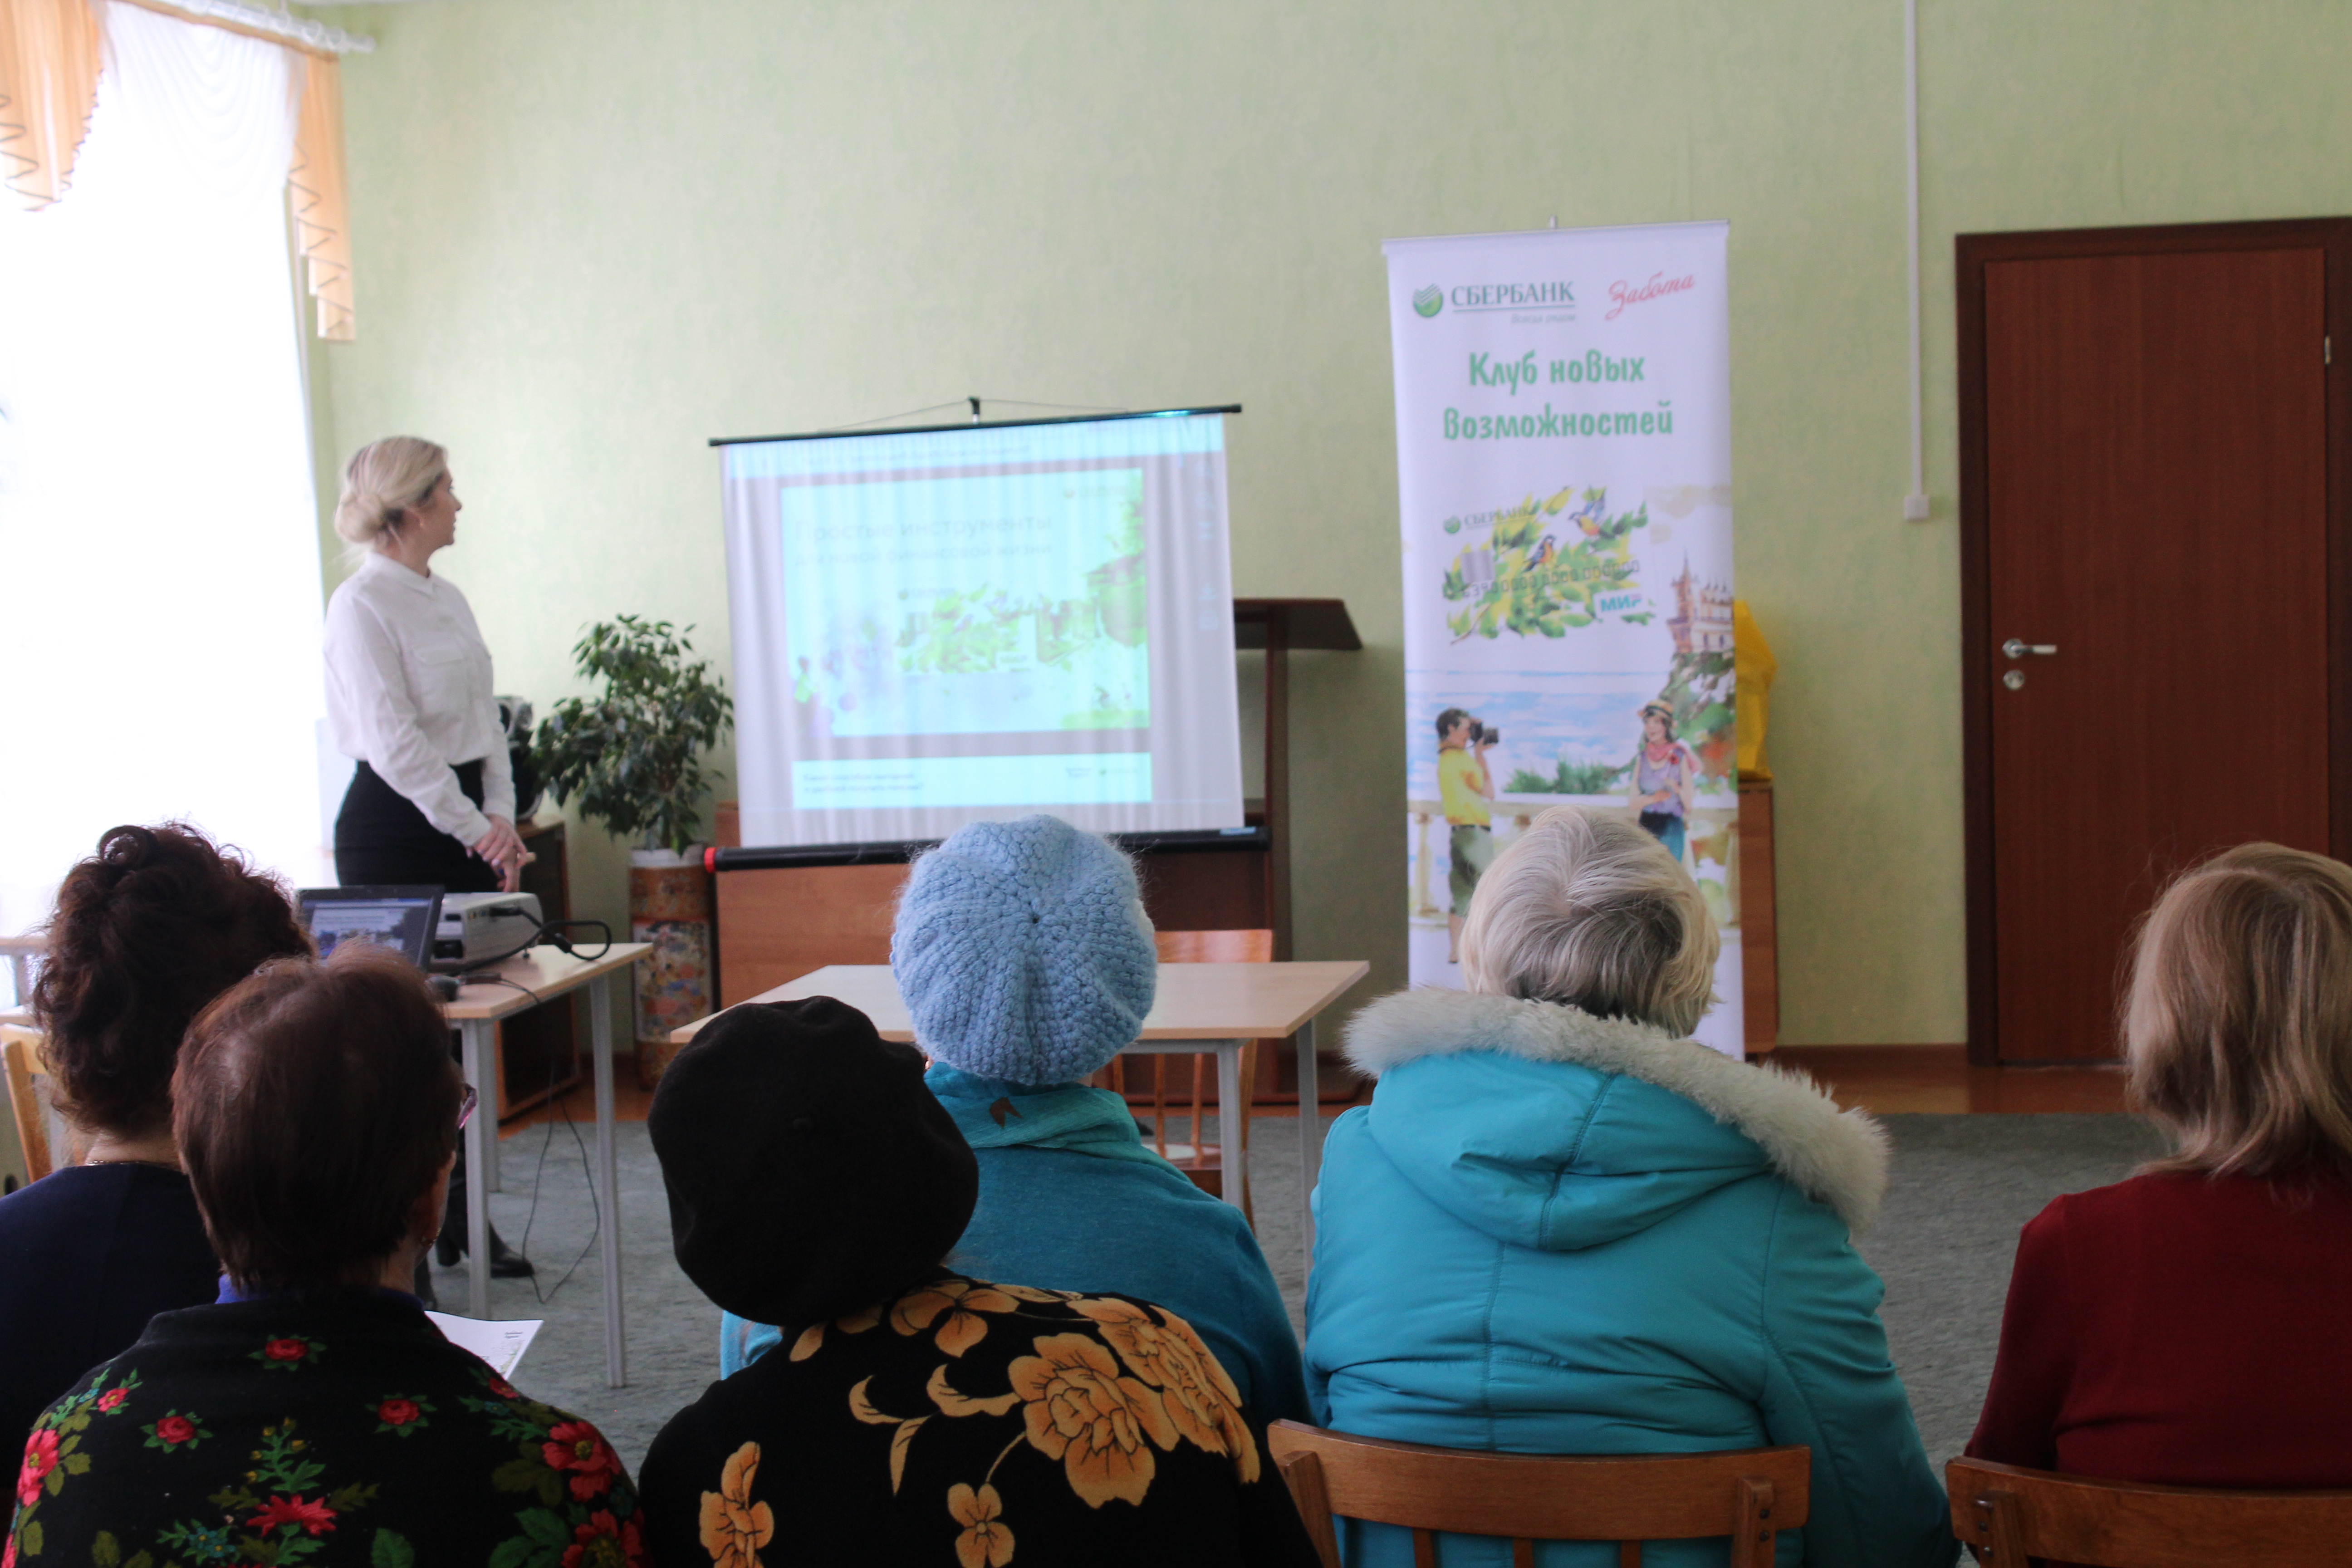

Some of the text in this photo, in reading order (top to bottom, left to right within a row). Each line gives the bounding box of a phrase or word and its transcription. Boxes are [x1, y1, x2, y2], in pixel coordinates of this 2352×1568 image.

[1451, 281, 1574, 307] СБЕРБАНК
[1605, 271, 1695, 320] Забота
[1469, 349, 1645, 396] Клуб новых
[795, 516, 1052, 545] Простые инструменты
[829, 548, 881, 564] новой
[885, 543, 991, 564] финансовой
[996, 544, 1052, 556] жизни
[1601, 593, 1641, 612] МИР
